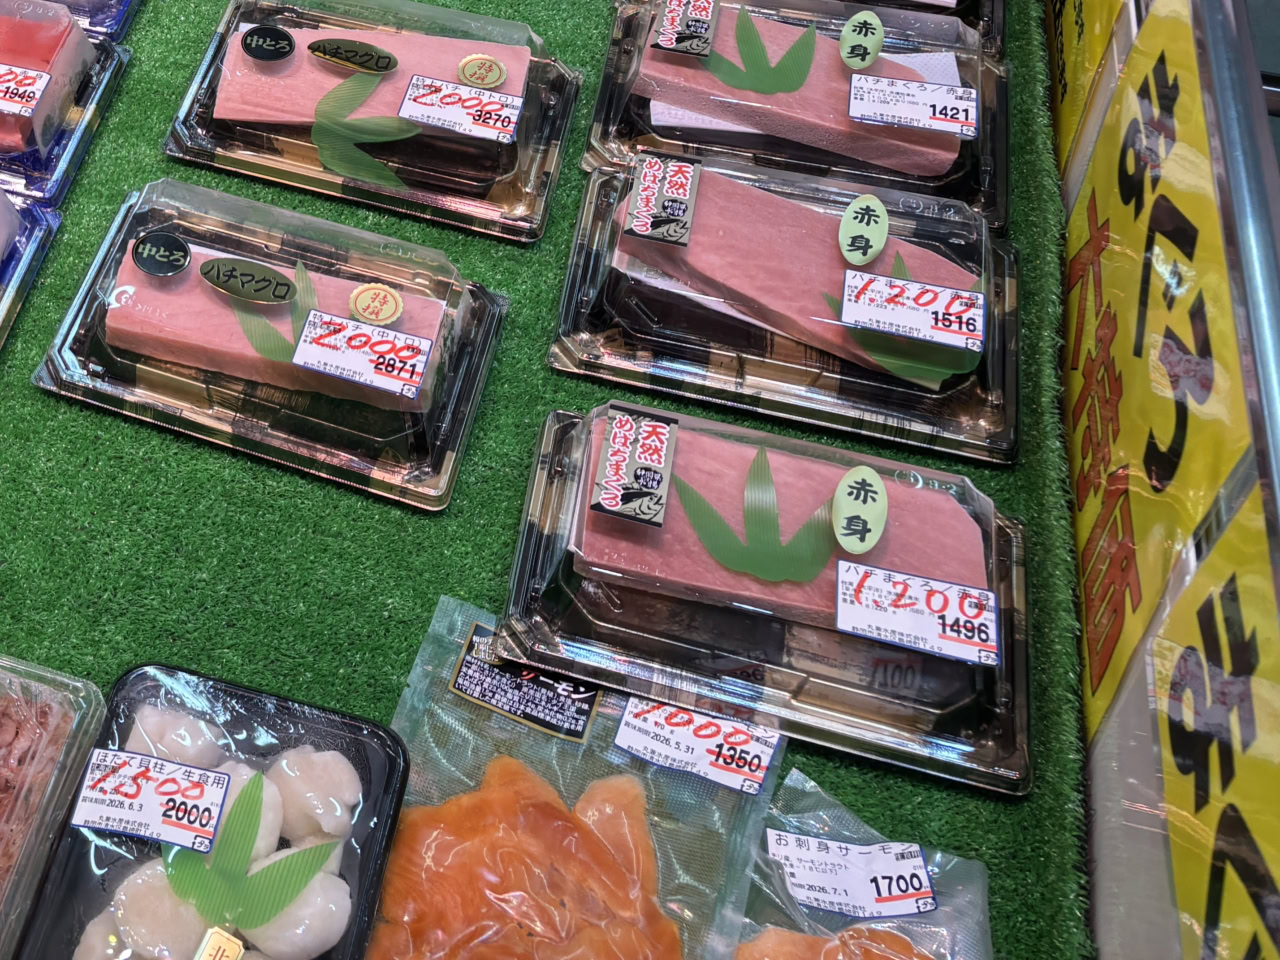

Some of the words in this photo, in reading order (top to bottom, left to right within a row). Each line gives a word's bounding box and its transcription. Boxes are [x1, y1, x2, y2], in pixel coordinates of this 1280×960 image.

[247, 34, 291, 54] 中とろ
[846, 20, 878, 62] 赤身
[312, 43, 392, 70] バチマグロ
[3, 85, 36, 103] 1949
[472, 109, 511, 128] 3270
[929, 104, 969, 122] 1421
[664, 164, 694, 198] 天然
[846, 206, 879, 257] 赤身
[138, 243, 184, 266] 中とろ
[206, 263, 292, 301] バチマグロ
[930, 310, 977, 332] 1516
[374, 355, 417, 380] 2871
[636, 423, 667, 466] 天然
[839, 478, 881, 545] 赤身
[938, 614, 990, 643] 1496
[96, 751, 226, 790] ほたて貝柱／生食用
[715, 742, 762, 773] 1350
[162, 797, 213, 829] 2000
[775, 833, 914, 855] お刺身サーモン
[870, 873, 923, 898] 1700
